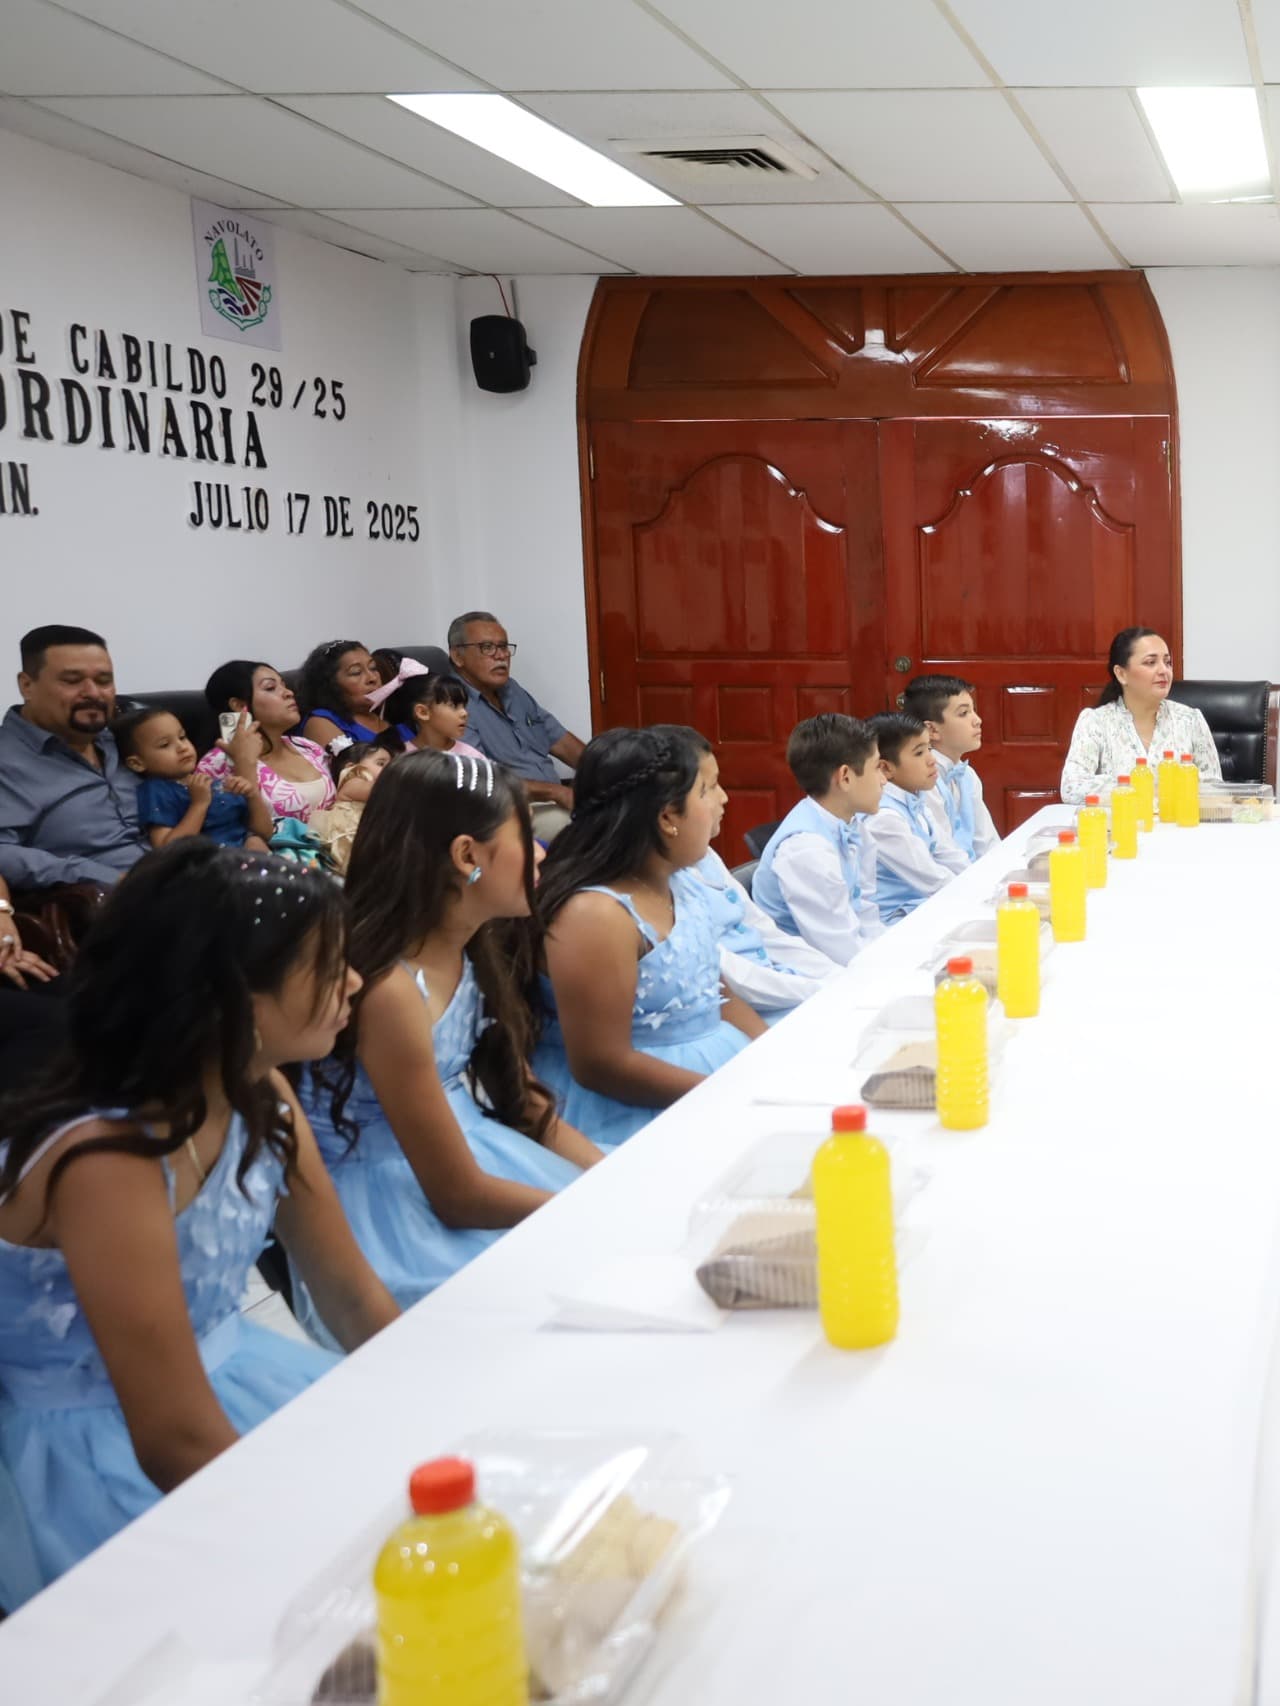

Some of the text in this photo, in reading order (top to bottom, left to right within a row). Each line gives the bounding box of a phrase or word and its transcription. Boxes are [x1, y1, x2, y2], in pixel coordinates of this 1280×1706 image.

[204, 220, 263, 261] NAVOLATO
[0, 310, 346, 421] E CABILDO 29/25
[190, 481, 269, 530] JULIO
[287, 492, 310, 534] 17
[324, 496, 353, 536] DE
[367, 501, 420, 541] 2025
